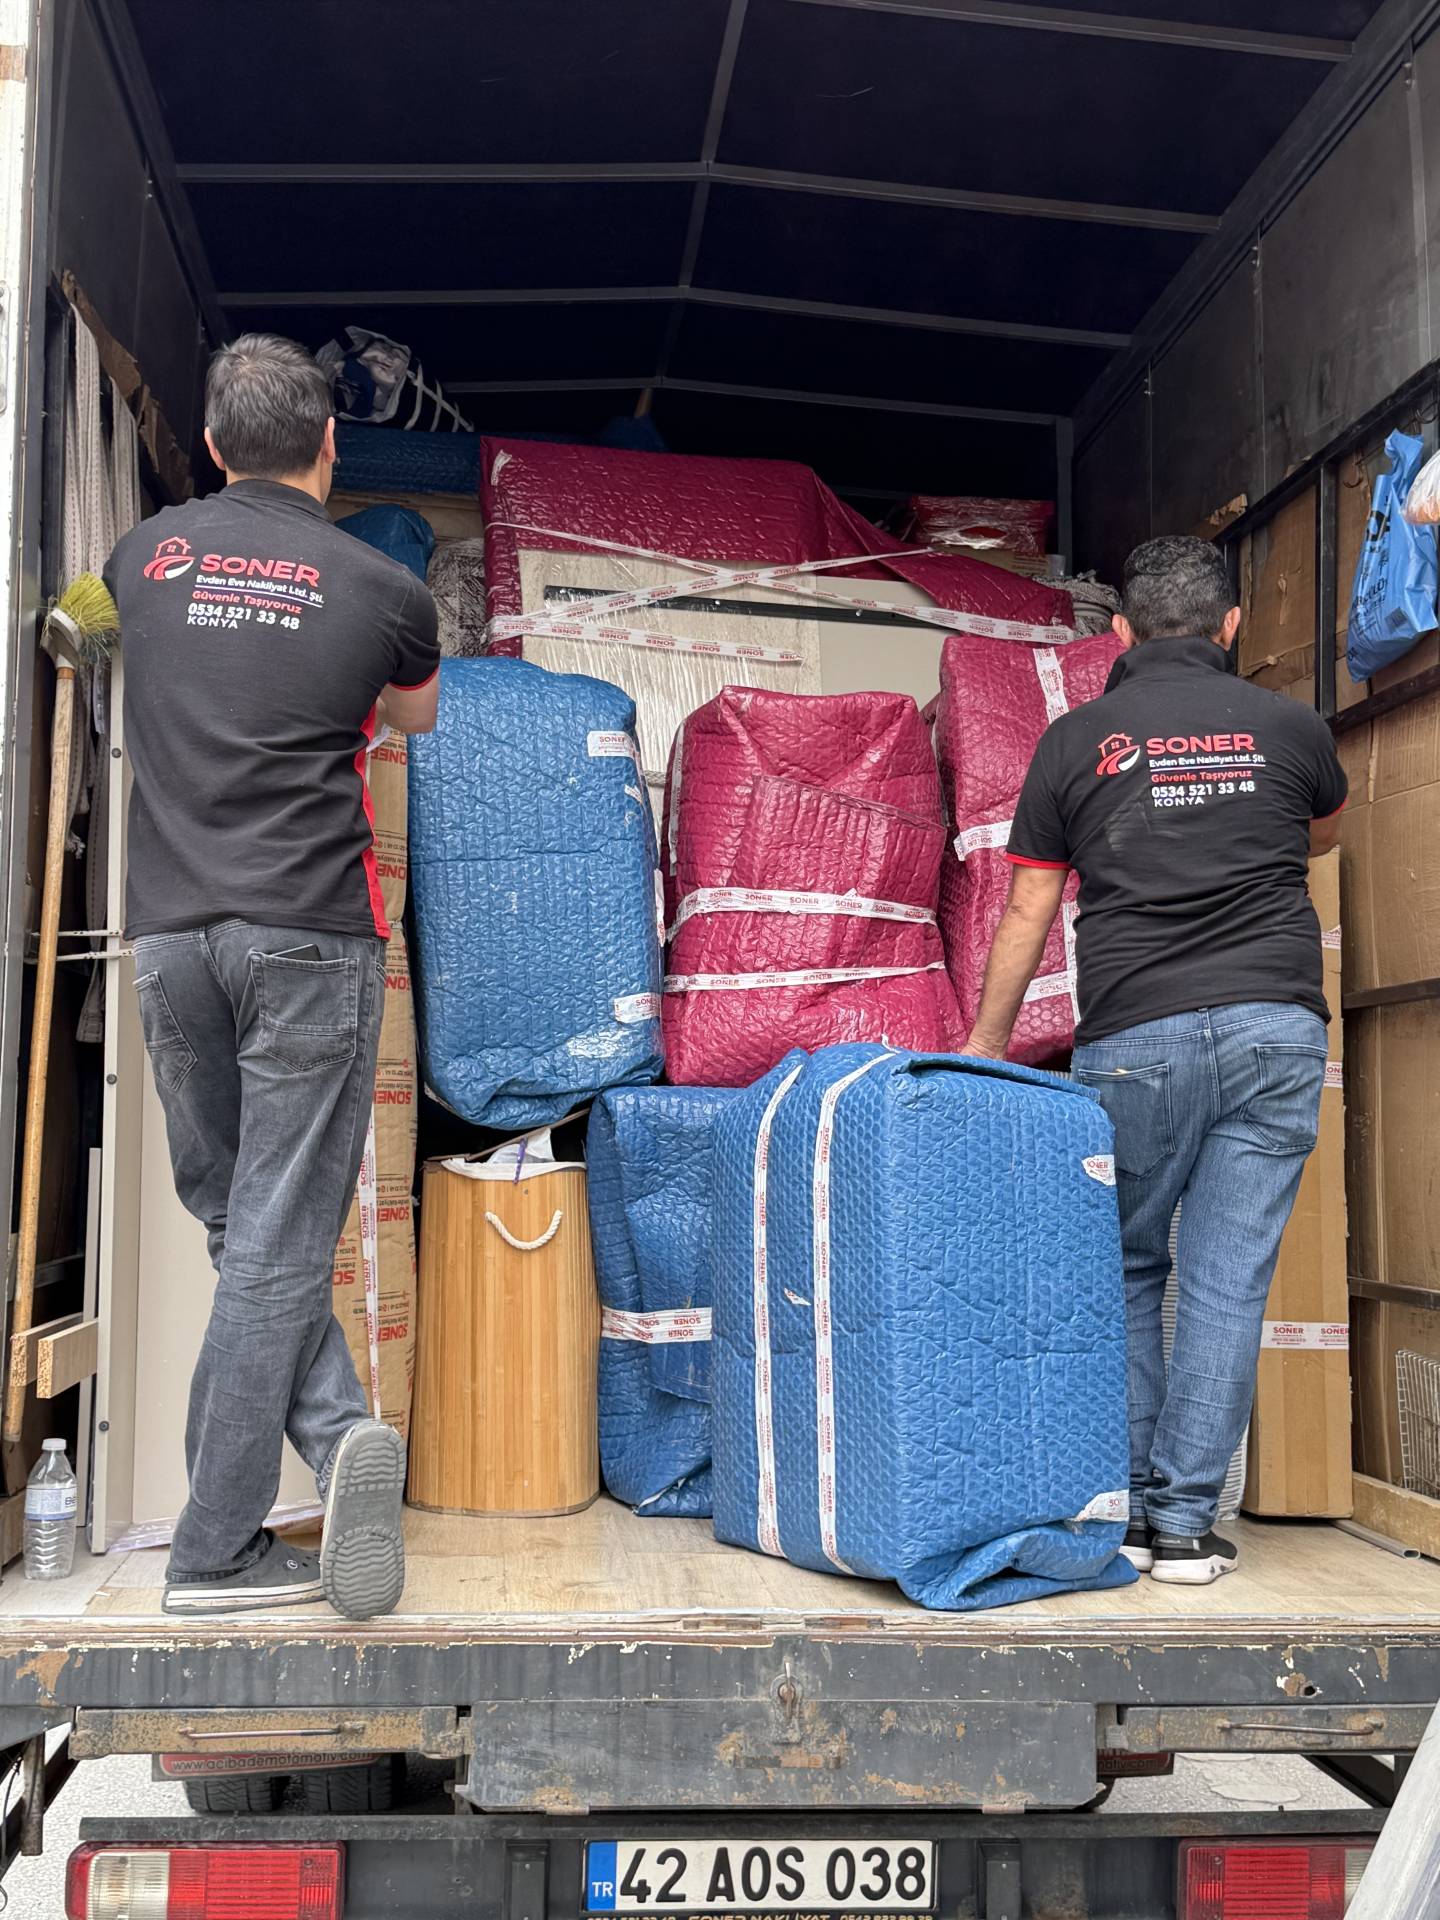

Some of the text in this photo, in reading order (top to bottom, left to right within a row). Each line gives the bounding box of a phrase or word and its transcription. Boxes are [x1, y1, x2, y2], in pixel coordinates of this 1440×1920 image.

[200, 554, 320, 587] SONER
[196, 575, 226, 586] Evden
[228, 577, 246, 588] Eve
[288, 584, 308, 599] Ltd.
[192, 590, 302, 614] Güvenle Taşıyoruz
[187, 602, 300, 630] 0534 521 33 48
[187, 614, 238, 629] KONYA
[551, 627, 582, 635] SONER
[599, 632, 629, 641] SONER
[646, 638, 676, 647] SONER
[691, 644, 720, 652] SONER
[736, 648, 765, 657] SONER
[1146, 733, 1256, 757] SONER
[1149, 759, 1178, 768] Evden
[1178, 758, 1195, 766] Eve
[1151, 770, 1252, 783] Güvenle Taşıyoruz
[1151, 780, 1255, 798] 0534 521 33 48
[1154, 796, 1204, 807] KONYA
[745, 893, 773, 902] SONER
[789, 896, 819, 905] SONER
[835, 899, 863, 910] SONER
[709, 978, 740, 986] SONER
[755, 977, 786, 985] SONER
[803, 973, 833, 982] SONER
[372, 1090, 412, 1105] SONE
[376, 1206, 409, 1222] SONE
[674, 1317, 701, 1325] SONER
[376, 1324, 408, 1342] SONE
[668, 1329, 694, 1338] SONER
[1273, 1326, 1304, 1335] SONER
[619, 1846, 926, 1904] 42 AOS 038
[592, 1881, 613, 1898] TR
